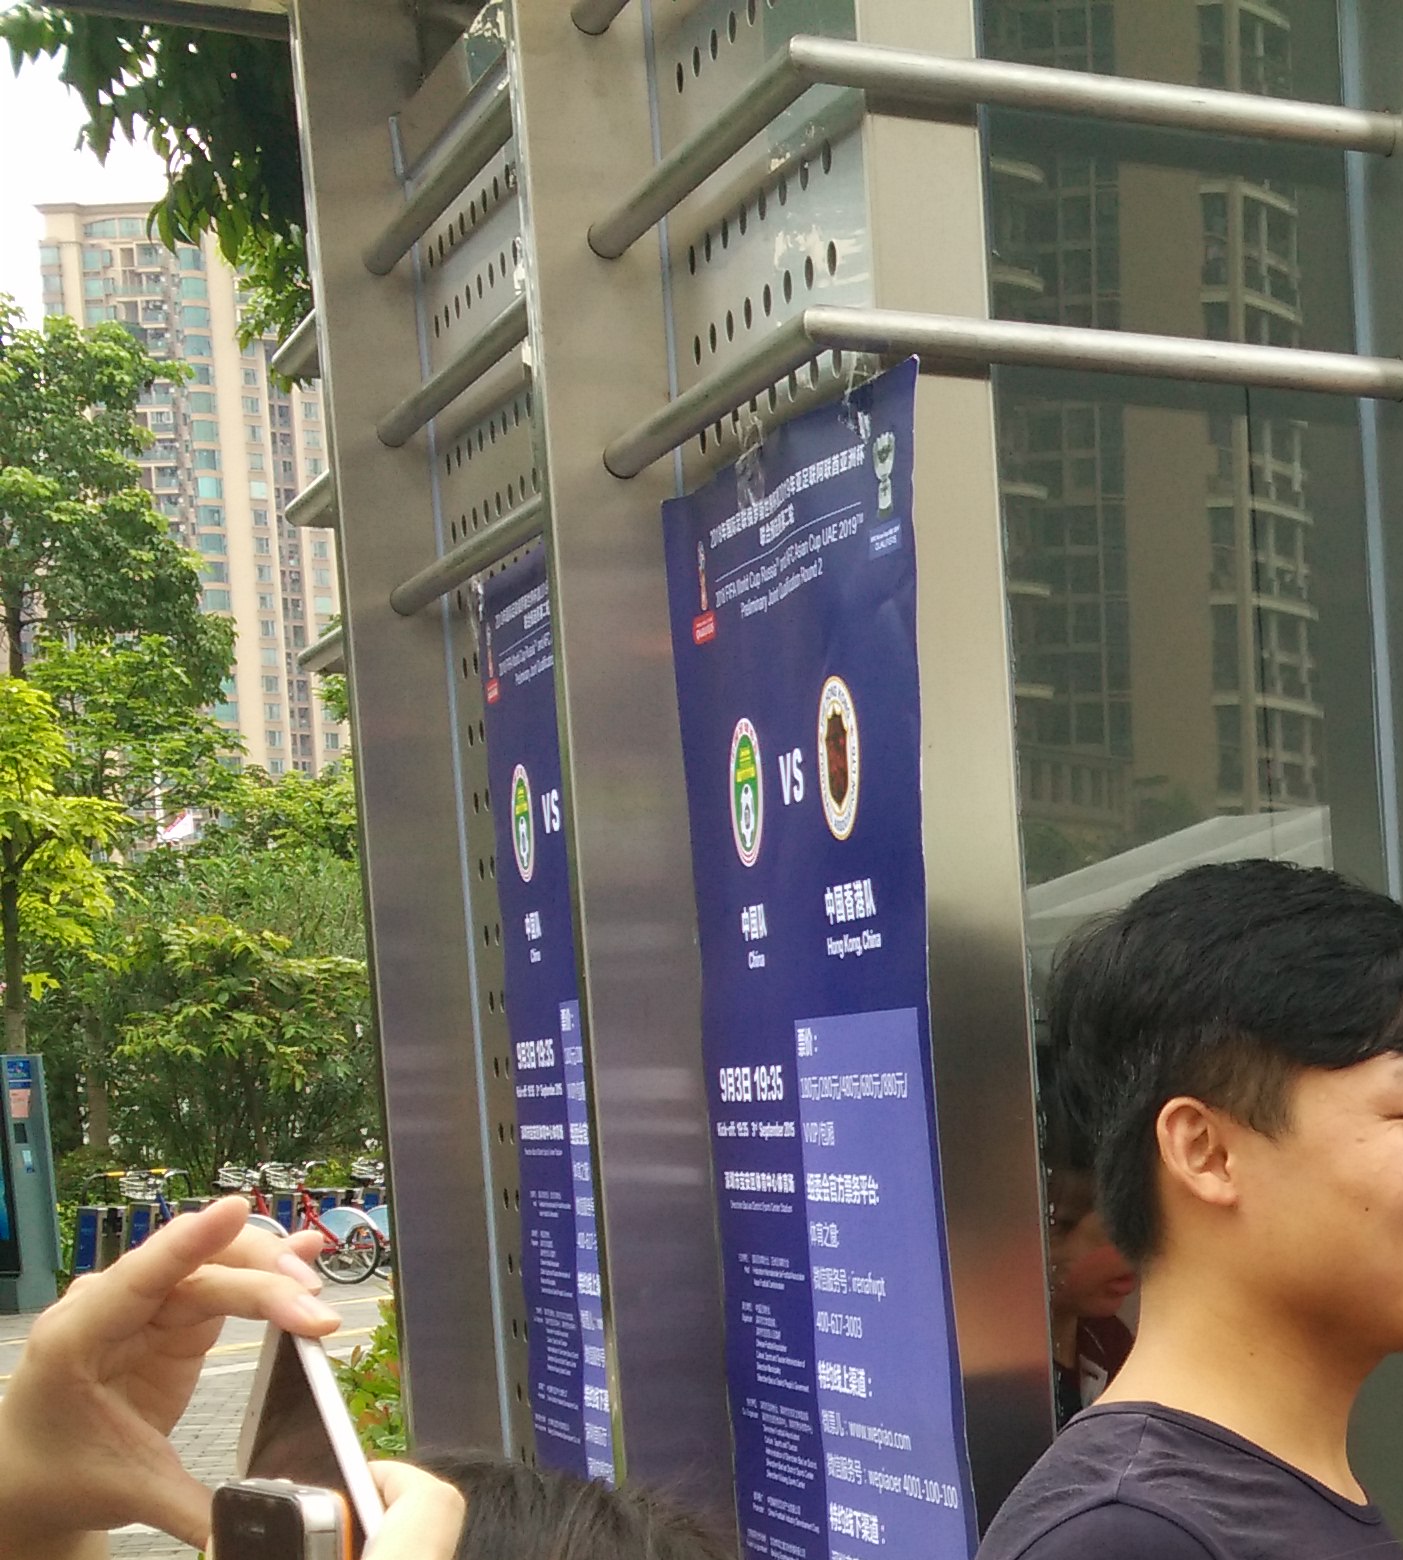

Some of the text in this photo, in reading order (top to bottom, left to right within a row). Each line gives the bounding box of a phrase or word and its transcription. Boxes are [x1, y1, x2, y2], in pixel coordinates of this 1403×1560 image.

[822, 527, 838, 547] UAE
[778, 747, 804, 805] VS
[541, 788, 561, 834] VS
[741, 878, 877, 942] 中国队 中国香港队
[719, 1064, 784, 1102] 9月3日 19:35
